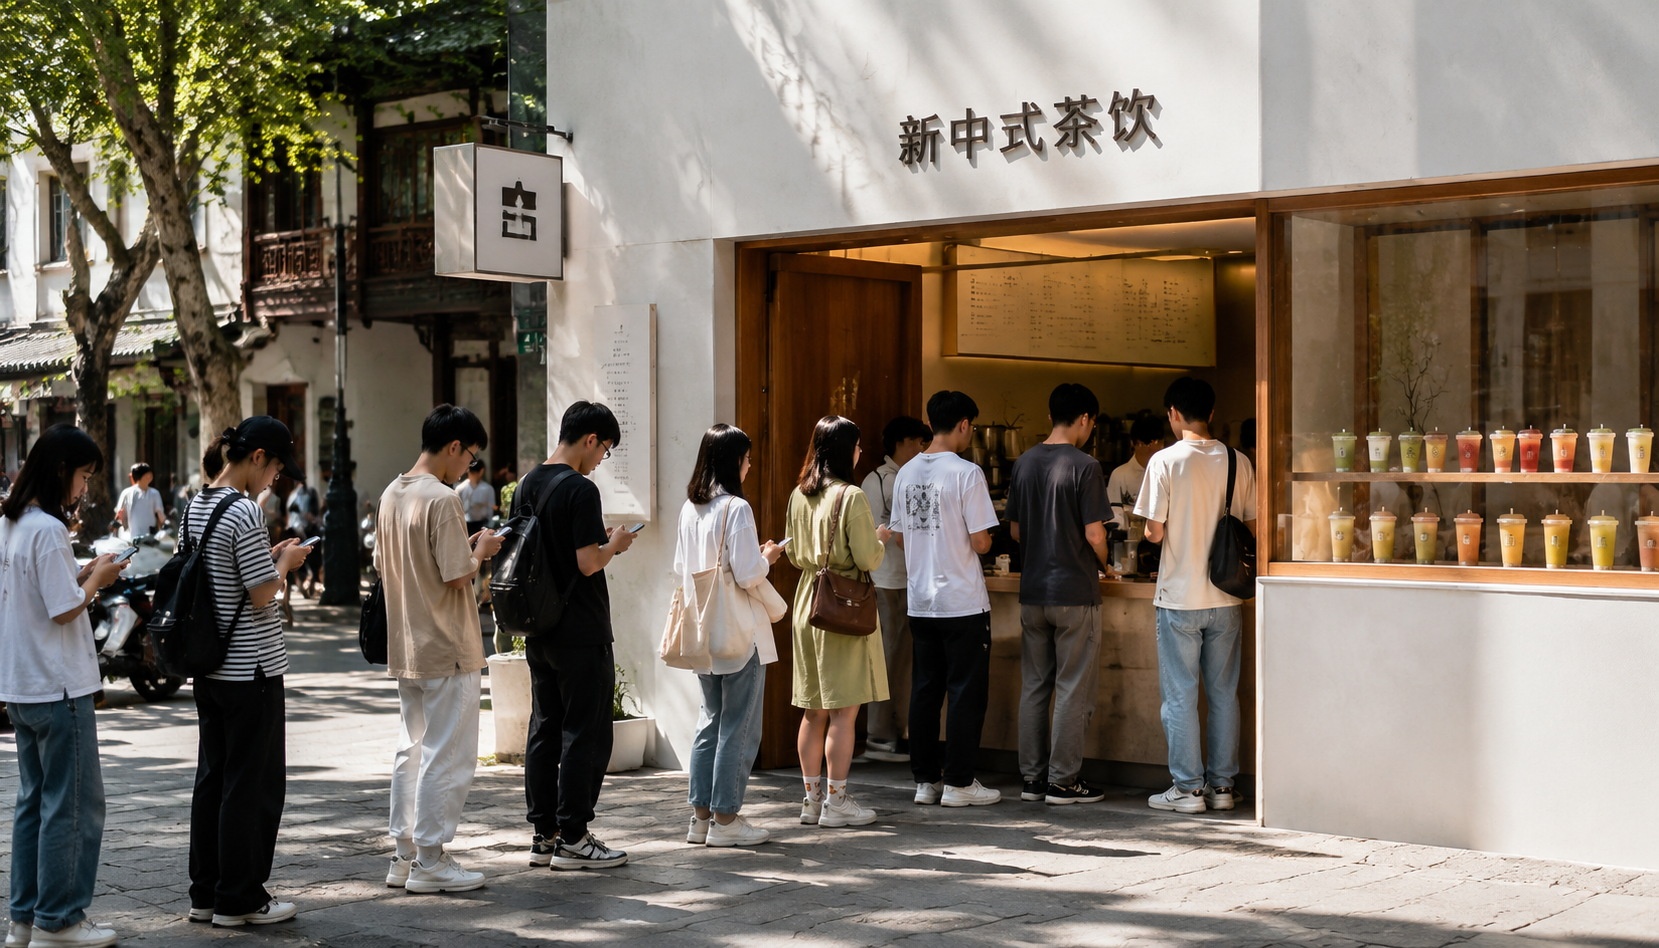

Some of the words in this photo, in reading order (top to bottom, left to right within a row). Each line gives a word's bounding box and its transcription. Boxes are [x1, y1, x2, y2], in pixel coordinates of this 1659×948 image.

[899, 88, 1156, 165] 新中式茶饮
